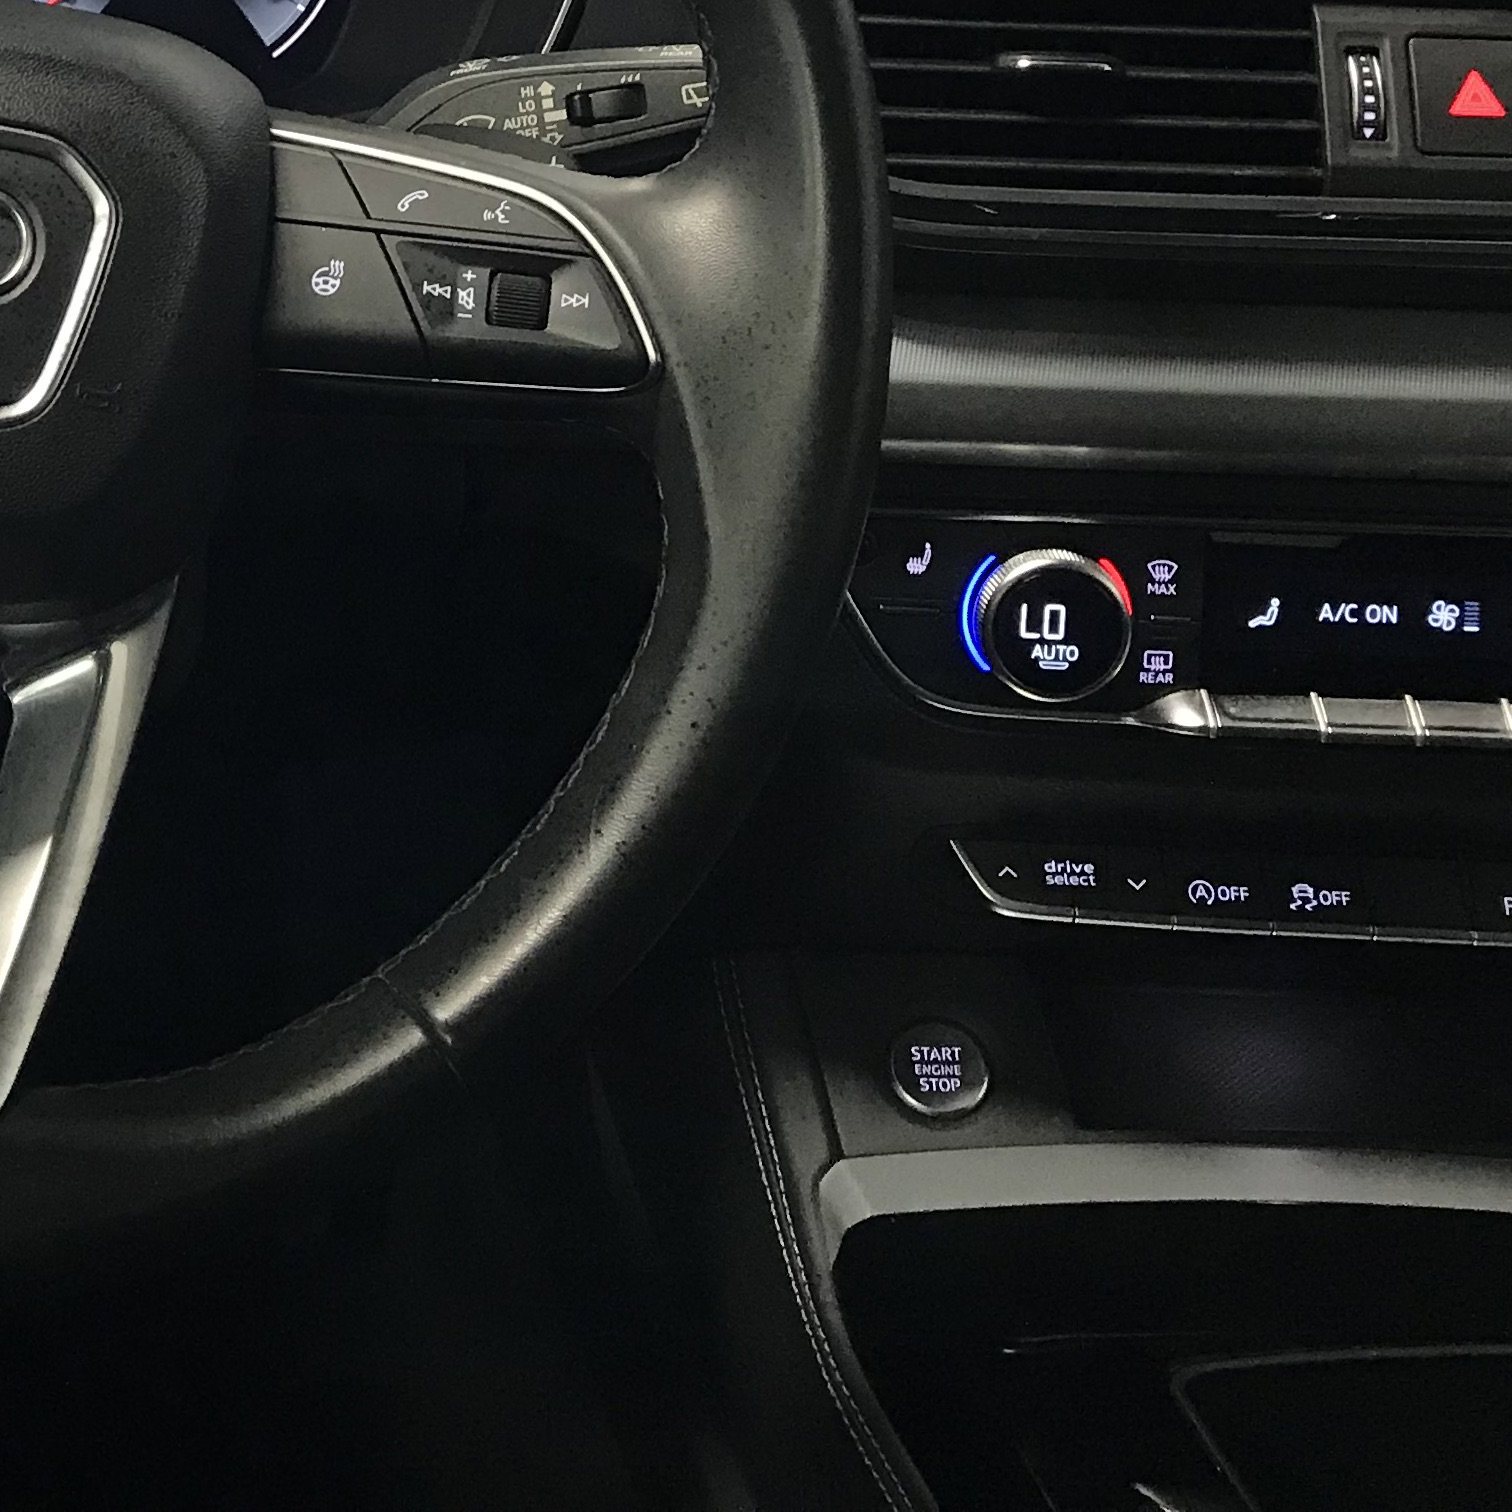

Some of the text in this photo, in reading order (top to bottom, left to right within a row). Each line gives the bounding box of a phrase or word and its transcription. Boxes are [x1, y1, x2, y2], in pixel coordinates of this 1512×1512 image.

[520, 85, 535, 98] HI
[518, 100, 536, 113] LO
[503, 114, 538, 131] AUTO
[1146, 583, 1177, 596] MAX
[1318, 603, 1398, 625] A/C ON
[1019, 604, 1066, 641] LO
[1031, 645, 1079, 662] AUTO
[1139, 671, 1174, 684] REAR
[1044, 859, 1094, 875] drive
[1045, 872, 1096, 887] select
[1217, 886, 1250, 903] OFF
[1319, 890, 1351, 907] OFF
[910, 1046, 961, 1062] START
[914, 1063, 961, 1076] ENGINE
[919, 1077, 961, 1093] STOP
